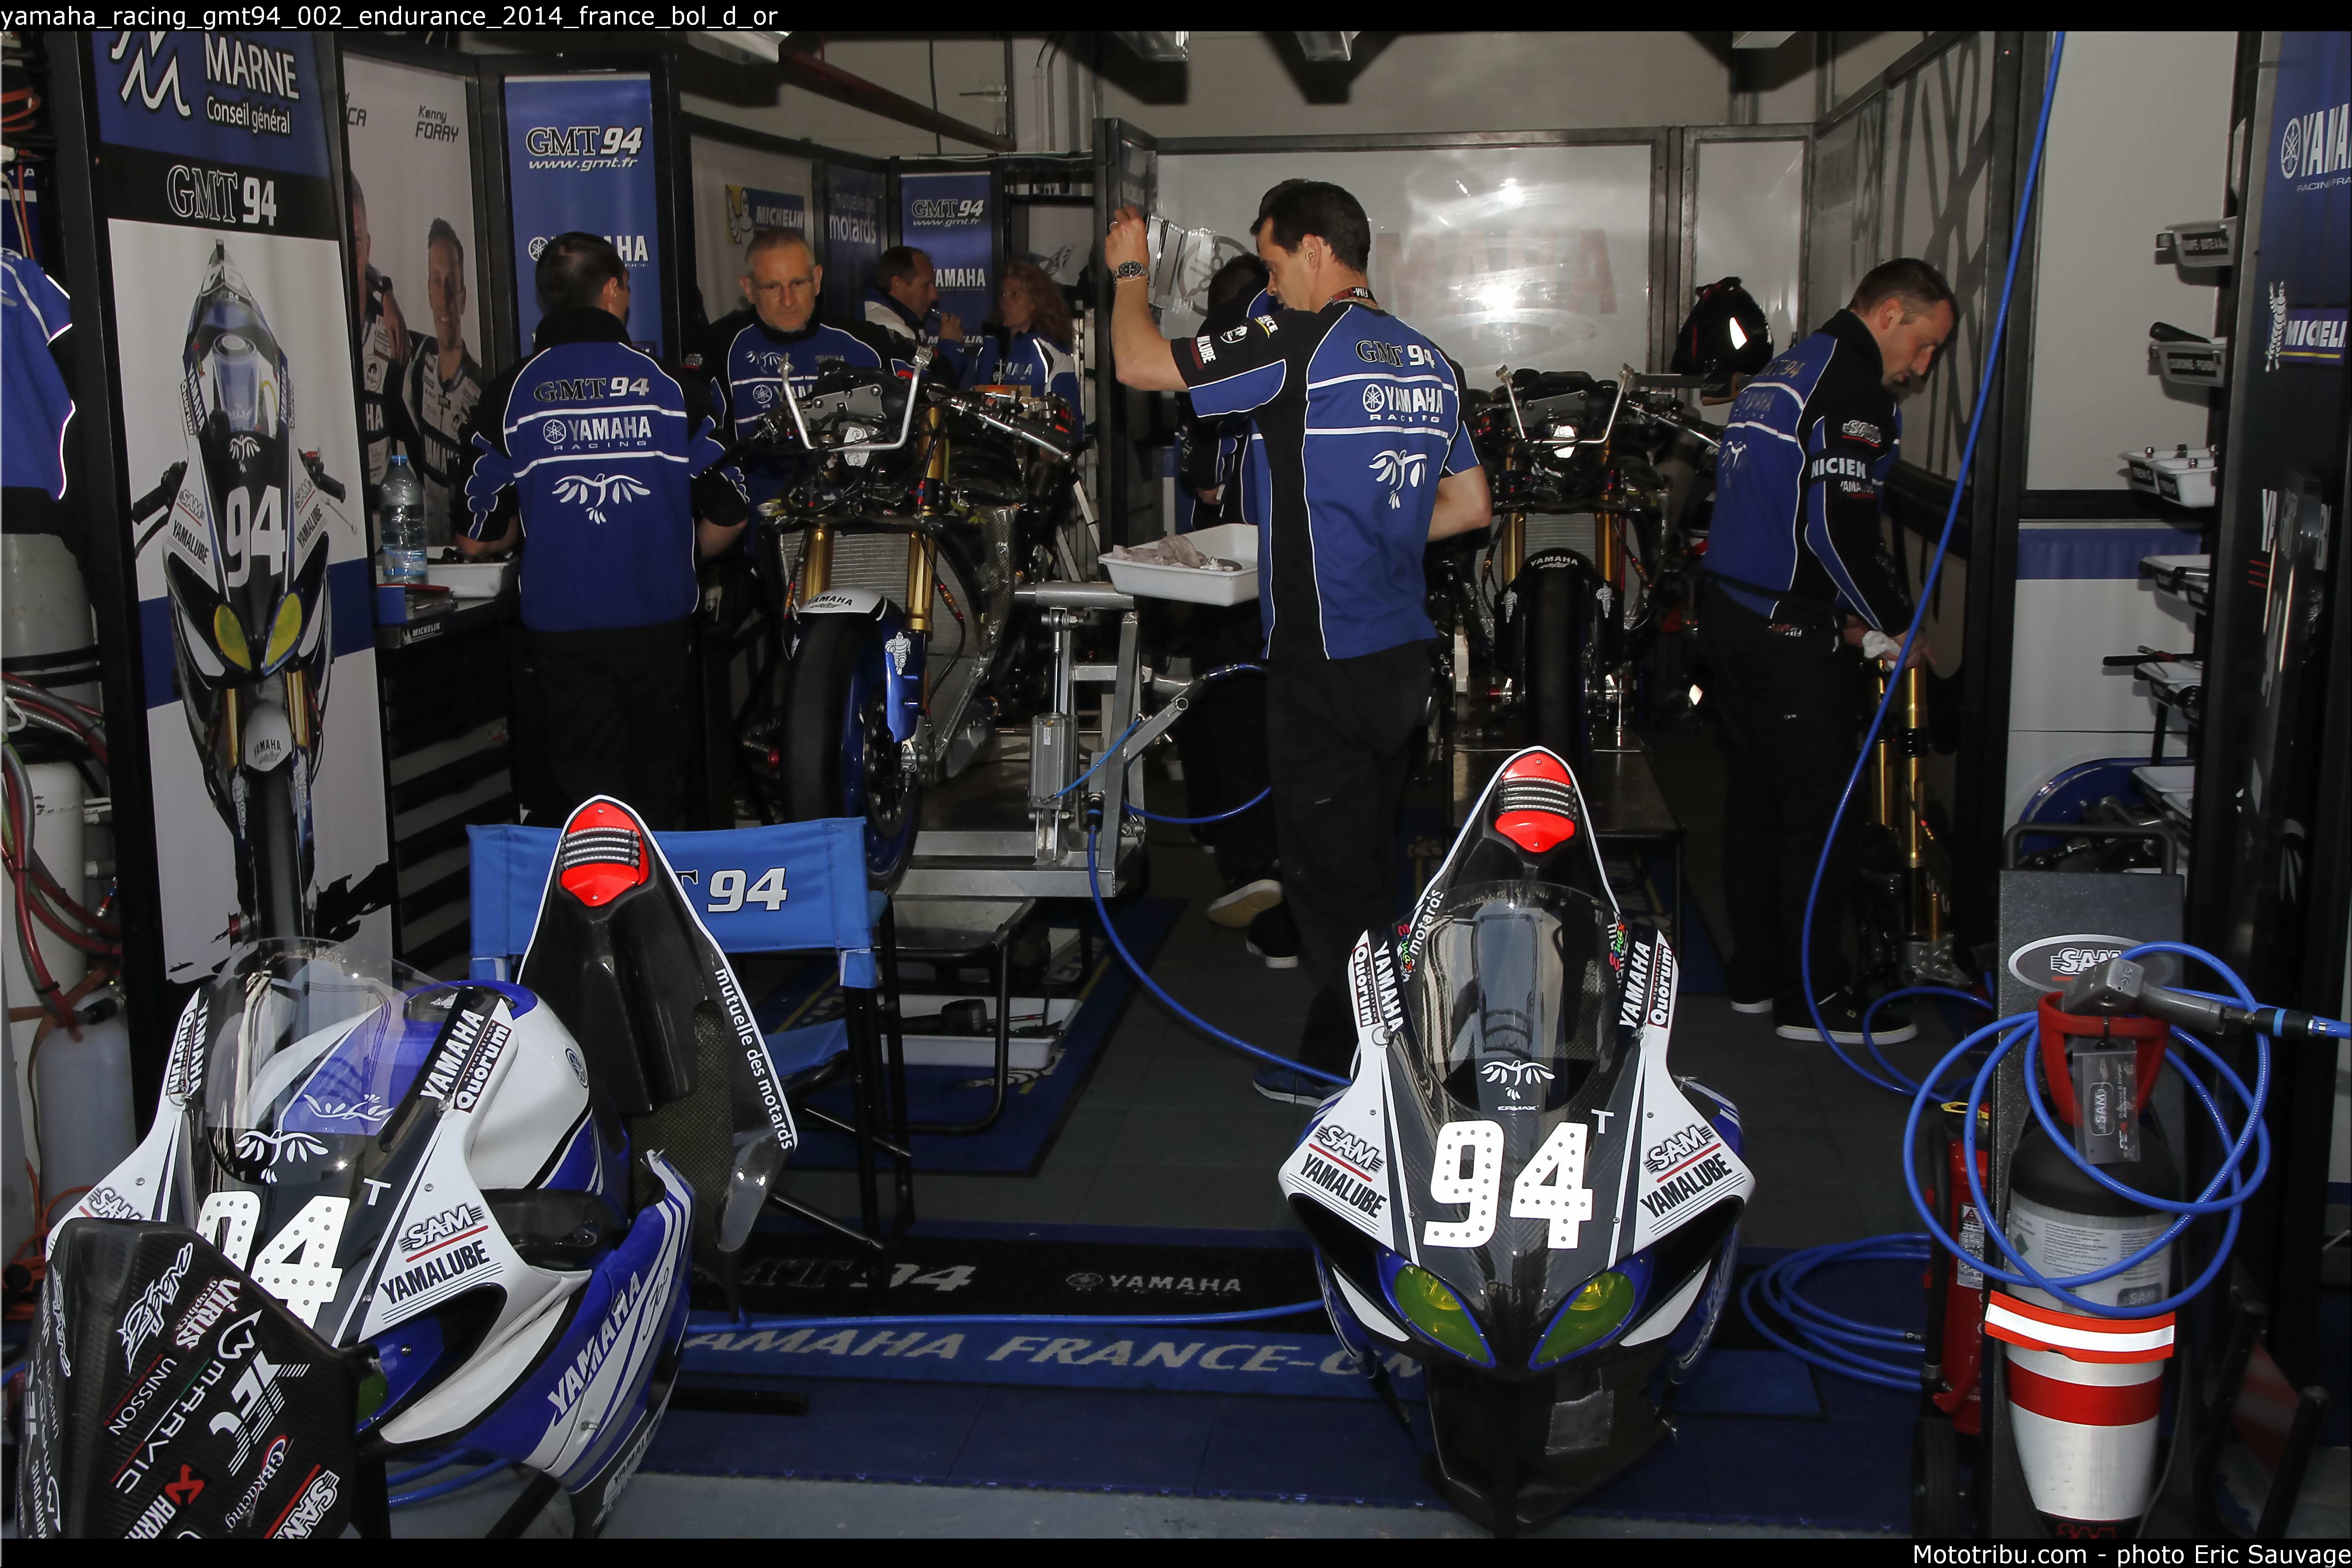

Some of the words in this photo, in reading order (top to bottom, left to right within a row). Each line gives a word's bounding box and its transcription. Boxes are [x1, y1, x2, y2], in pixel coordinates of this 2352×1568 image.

[205, 33, 300, 99] MARNE
[206, 96, 250, 127] Conseil
[252, 103, 291, 135] général
[415, 122, 459, 143] FORAY
[419, 104, 447, 123] Kenny
[526, 126, 600, 156] GMT
[600, 127, 644, 155] 94
[2301, 103, 2352, 177] YAMA
[529, 157, 638, 172] www.gmt.fr
[167, 165, 238, 224] GMT
[243, 176, 277, 226] 94
[756, 206, 805, 229] MICHELIN
[911, 199, 957, 218] GMT
[957, 199, 983, 217] 94
[829, 213, 876, 244] motards
[934, 268, 986, 287] AMAHA
[1355, 340, 1404, 368] GMT
[1408, 345, 1435, 368] 94
[188, 368, 205, 432] YAMAHA
[534, 378, 607, 402] GMT
[609, 377, 650, 398] 94
[1385, 385, 1444, 415] YAMAHA
[554, 441, 647, 451] RACING
[568, 416, 652, 442] YAMAHA
[180, 488, 205, 520] SAM
[296, 504, 323, 549] YAMALUBE
[172, 519, 209, 565] YAMALUBE
[227, 485, 286, 588] 94
[1530, 556, 1578, 567] YAMAHA
[807, 594, 853, 608] YAMAHA
[412, 622, 441, 637] MICHELIN
[253, 739, 282, 758] YAMAHA
[708, 867, 788, 913] 94
[1354, 946, 1373, 1026] Quorum
[1374, 940, 1404, 1032] YAMAHA
[1619, 941, 1651, 1029] YAMAHA
[1650, 947, 1672, 1025] Quorum
[168, 1011, 195, 1093] Quorum
[188, 997, 209, 1097] YAMAHA
[420, 1009, 485, 1101] YAMAHA
[455, 1025, 510, 1111] Quorum
[464, 1021, 496, 1082] signalétique
[714, 968, 753, 1047] mutuelle
[747, 1049, 766, 1077] des
[758, 1078, 794, 1150] motards
[1591, 1109, 1614, 1134] T
[2094, 1091, 2107, 1127] SAM
[1319, 1125, 1383, 1171] SAM
[1646, 1125, 1713, 1172] SAM
[364, 1178, 391, 1206] T
[1301, 1153, 1387, 1219] YAMALUBE
[1422, 1119, 1594, 1249] 94
[1639, 1153, 1733, 1219] YAMALUBE
[405, 1205, 477, 1249] SAM
[380, 1240, 490, 1305] YAMALUBE
[1109, 1274, 1242, 1292] YAMAHA
[547, 1271, 641, 1416] YAMAHA
[683, 1329, 965, 1360] AMAHA
[109, 1358, 177, 1436] UNISSON
